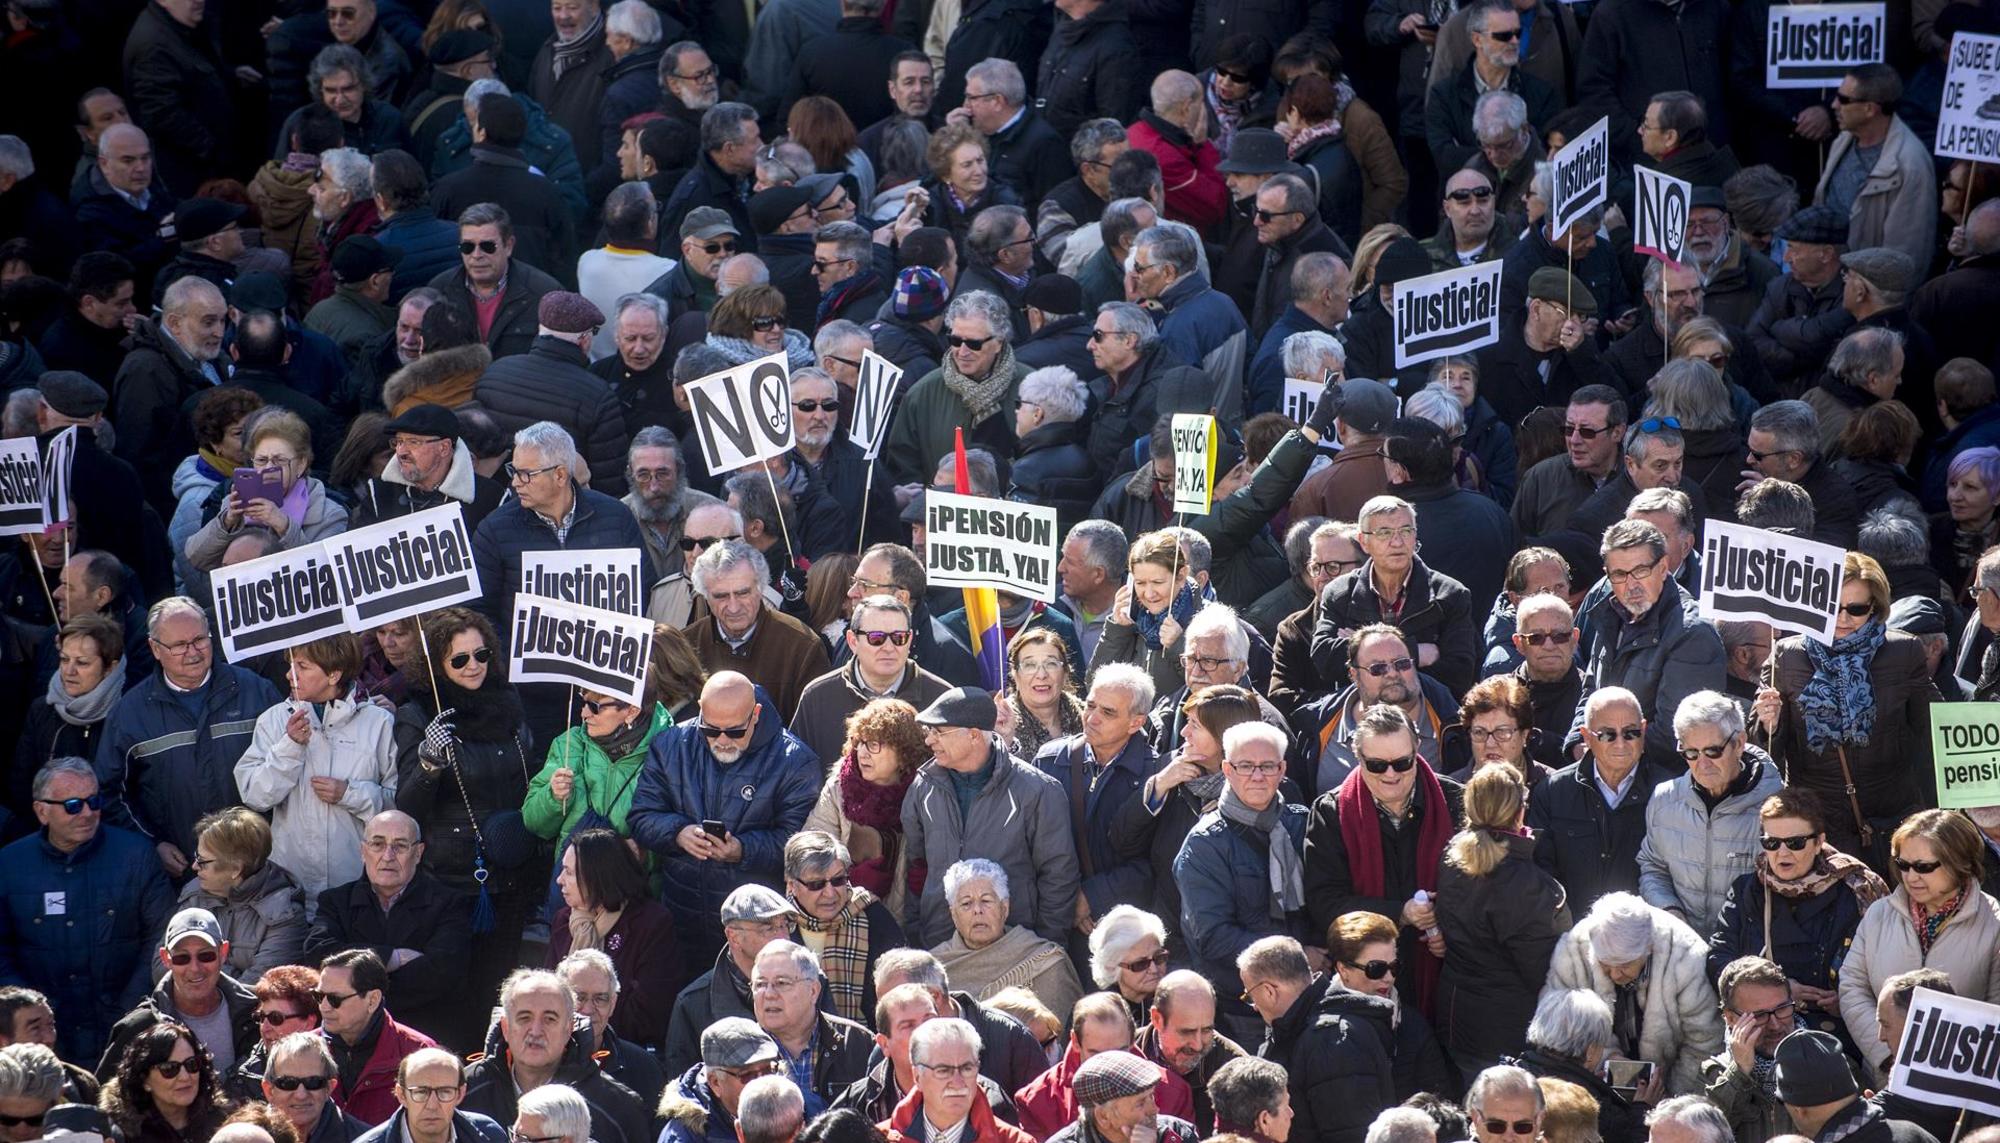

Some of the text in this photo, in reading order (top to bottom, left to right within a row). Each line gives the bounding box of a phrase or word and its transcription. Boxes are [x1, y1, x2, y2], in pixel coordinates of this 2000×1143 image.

[1770, 16, 1881, 66] ¡Justicia!
[1951, 40, 1994, 74] ¡SUBE
[1945, 81, 1965, 110] DE
[1939, 122, 1956, 152] LA
[1638, 172, 1686, 262] NO
[1397, 273, 1499, 346] ¡Justicia!
[690, 362, 790, 469] NO
[335, 518, 472, 606] ¡Justicia!
[929, 505, 1051, 546] ¡PENSIÓN
[217, 558, 342, 637] ¡Justicia
[929, 543, 1049, 585] JUSTA, YA!
[1704, 535, 1840, 615] ¡Justicia!
[513, 606, 649, 680] ¡Justicia!
[1944, 757, 2000, 789] pensi
[1900, 1007, 2000, 1082] ¡Justi
